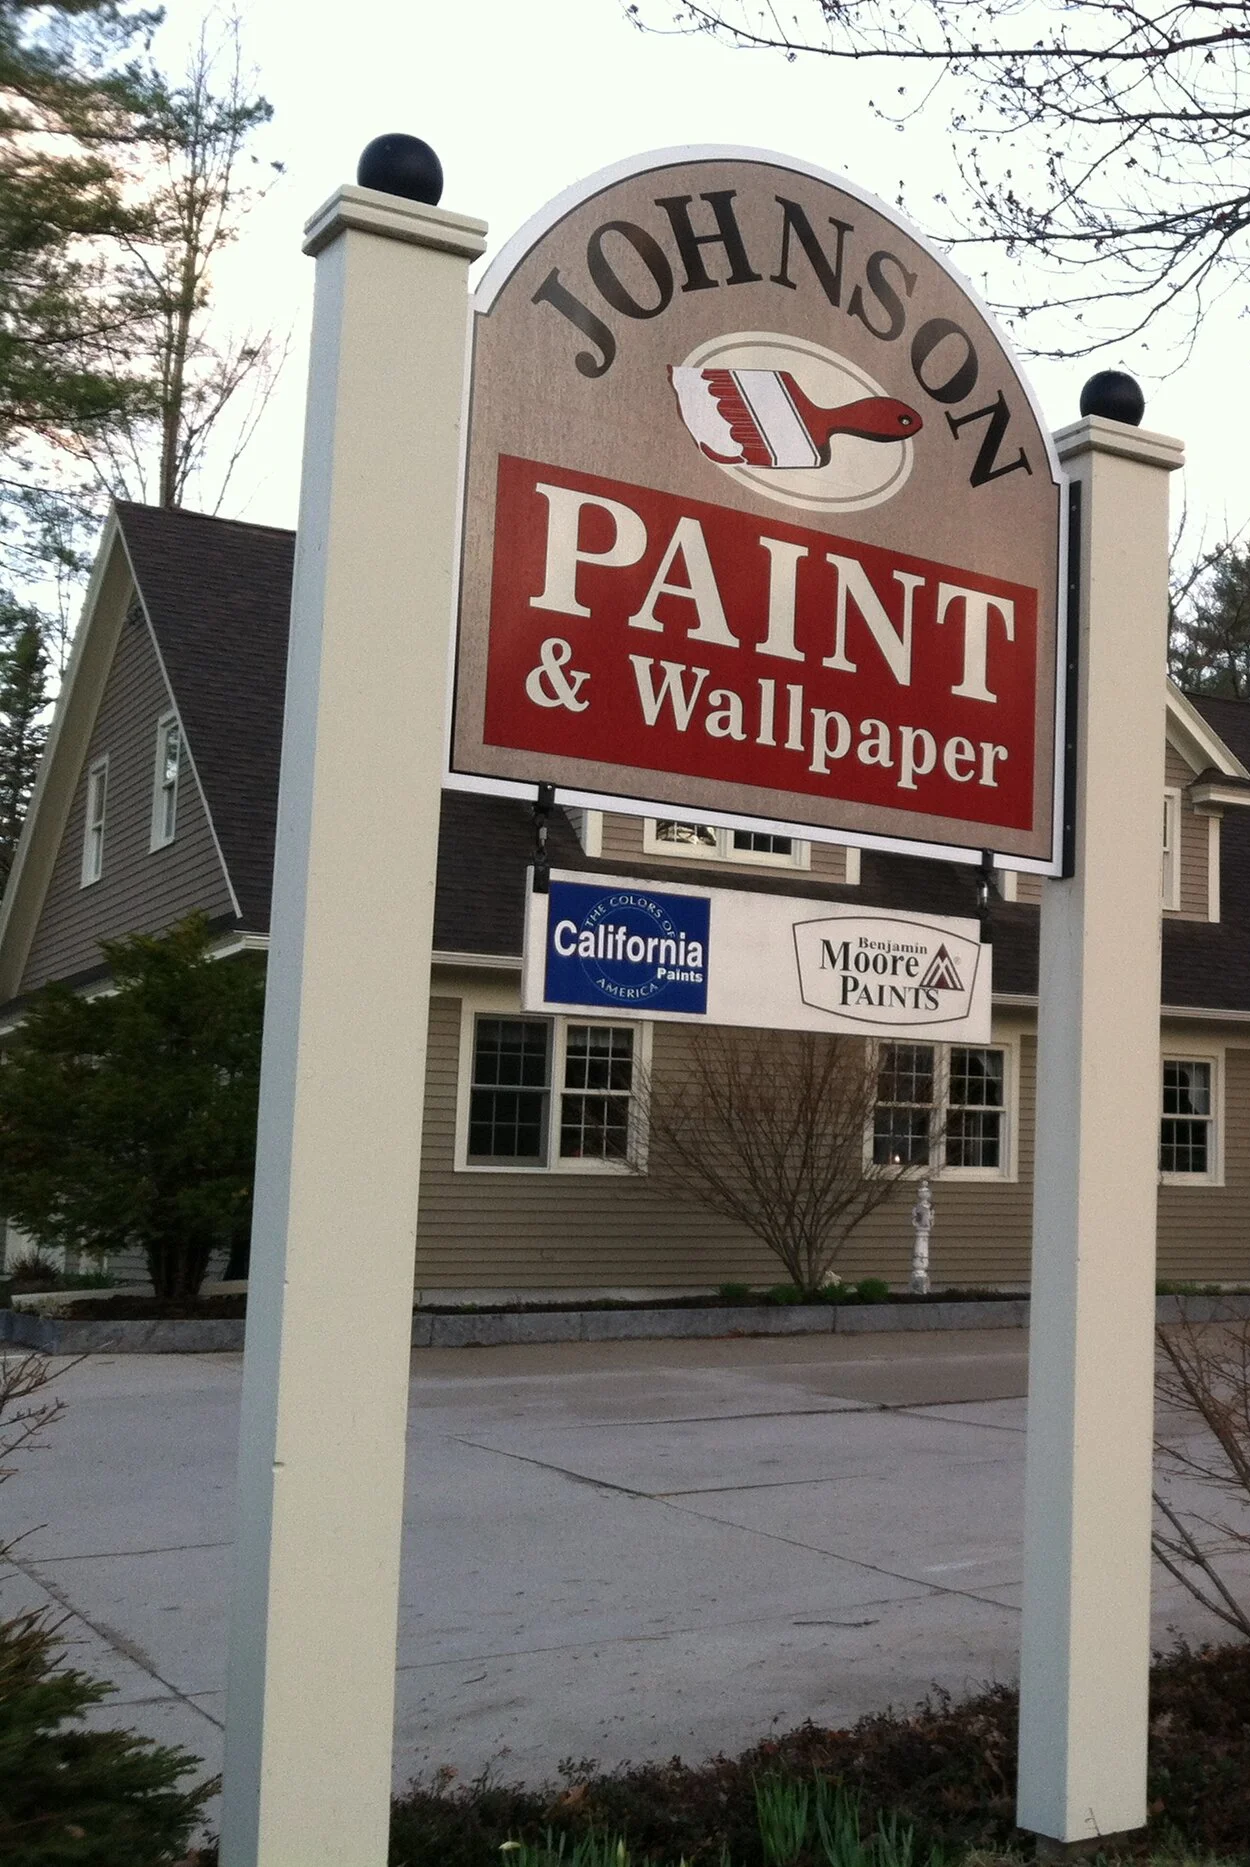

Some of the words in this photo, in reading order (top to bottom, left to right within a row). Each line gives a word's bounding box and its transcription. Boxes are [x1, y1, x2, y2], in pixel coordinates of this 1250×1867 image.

[532, 189, 1033, 489] JOHNSON
[529, 482, 1015, 703] PAINT
[525, 637, 591, 712] &
[628, 655, 1009, 789] Wallpaper
[585, 903, 607, 928] THE
[609, 895, 663, 918] COLORS
[662, 920, 676, 938] OF
[554, 919, 703, 967] California
[820, 938, 919, 977] Moore
[858, 937, 928, 955] Benjamin
[596, 978, 659, 998] AMERICA
[657, 967, 703, 983] Paints
[839, 975, 940, 1011] PAINTS
